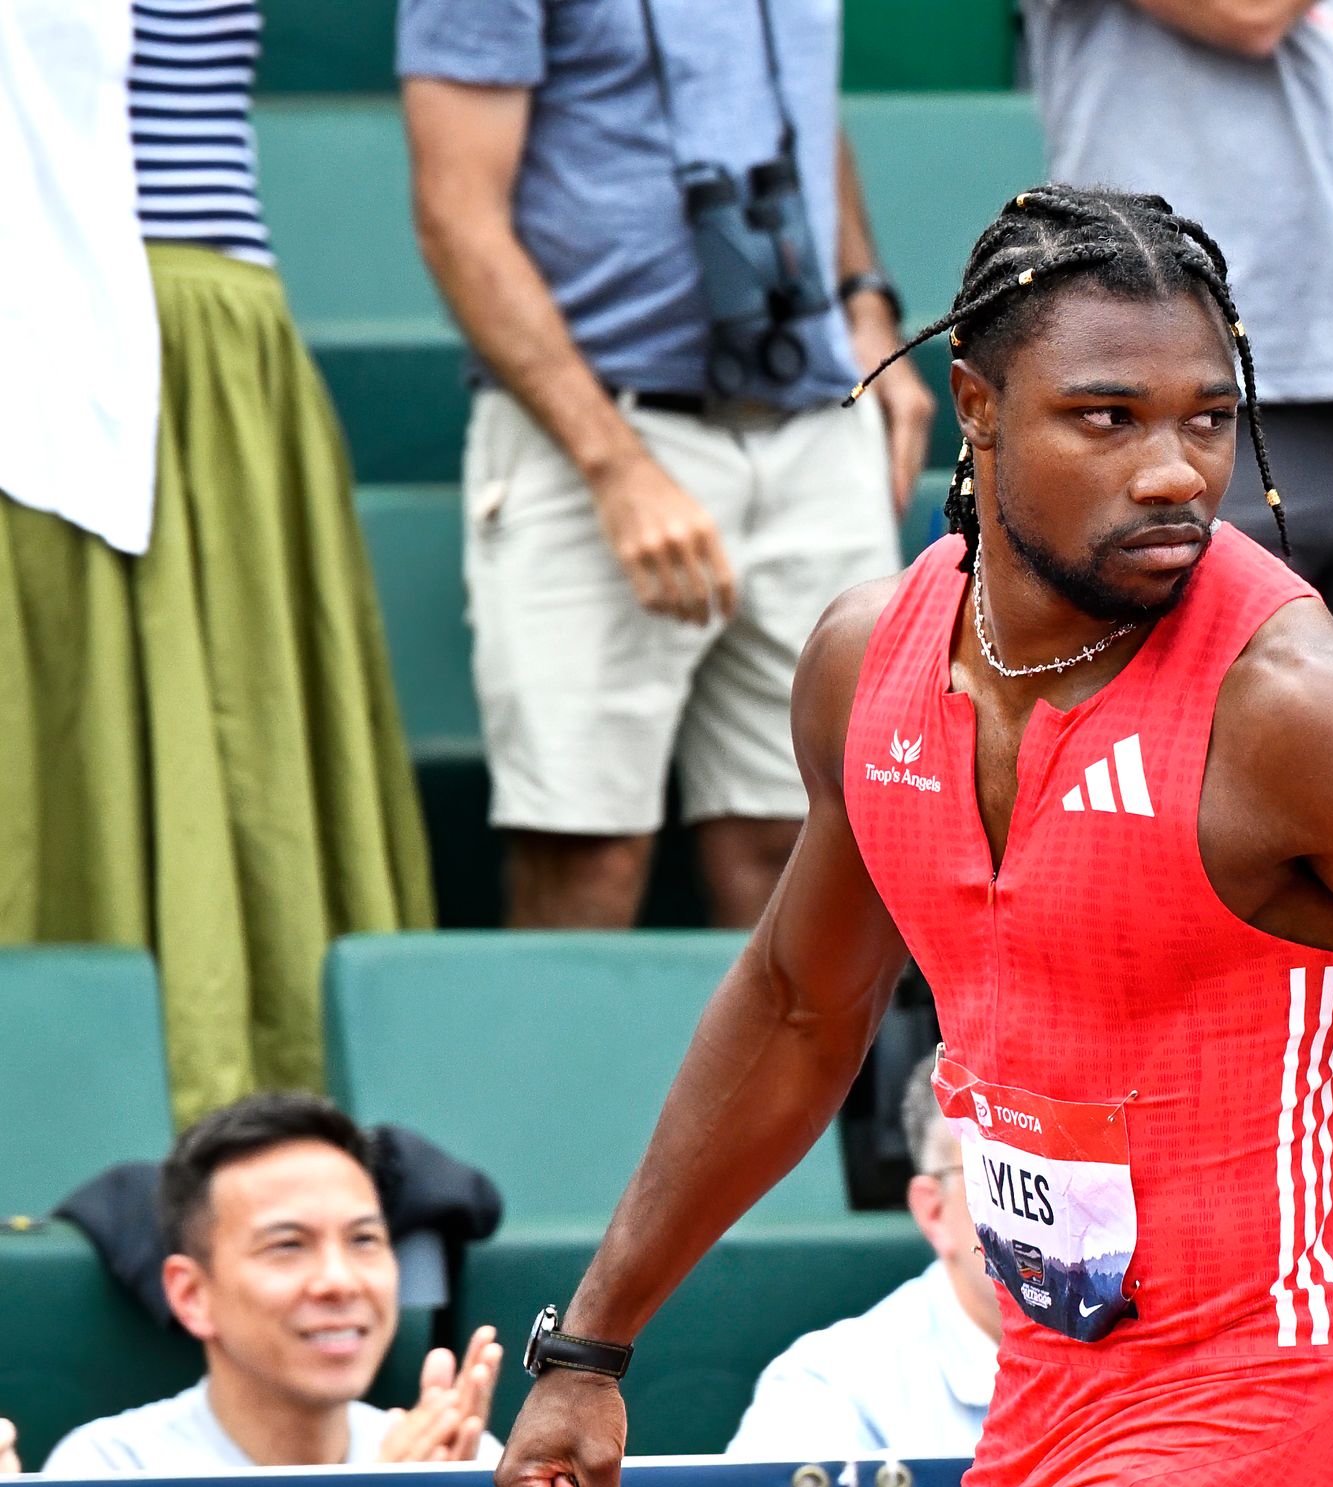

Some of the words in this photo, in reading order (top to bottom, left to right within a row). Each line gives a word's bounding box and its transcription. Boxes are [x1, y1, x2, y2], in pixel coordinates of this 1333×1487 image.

[865, 763, 900, 786] Tirop's
[901, 768, 941, 792] Angels
[994, 1105, 1042, 1134] TOYOTA
[982, 1154, 1055, 1225] LYLES
